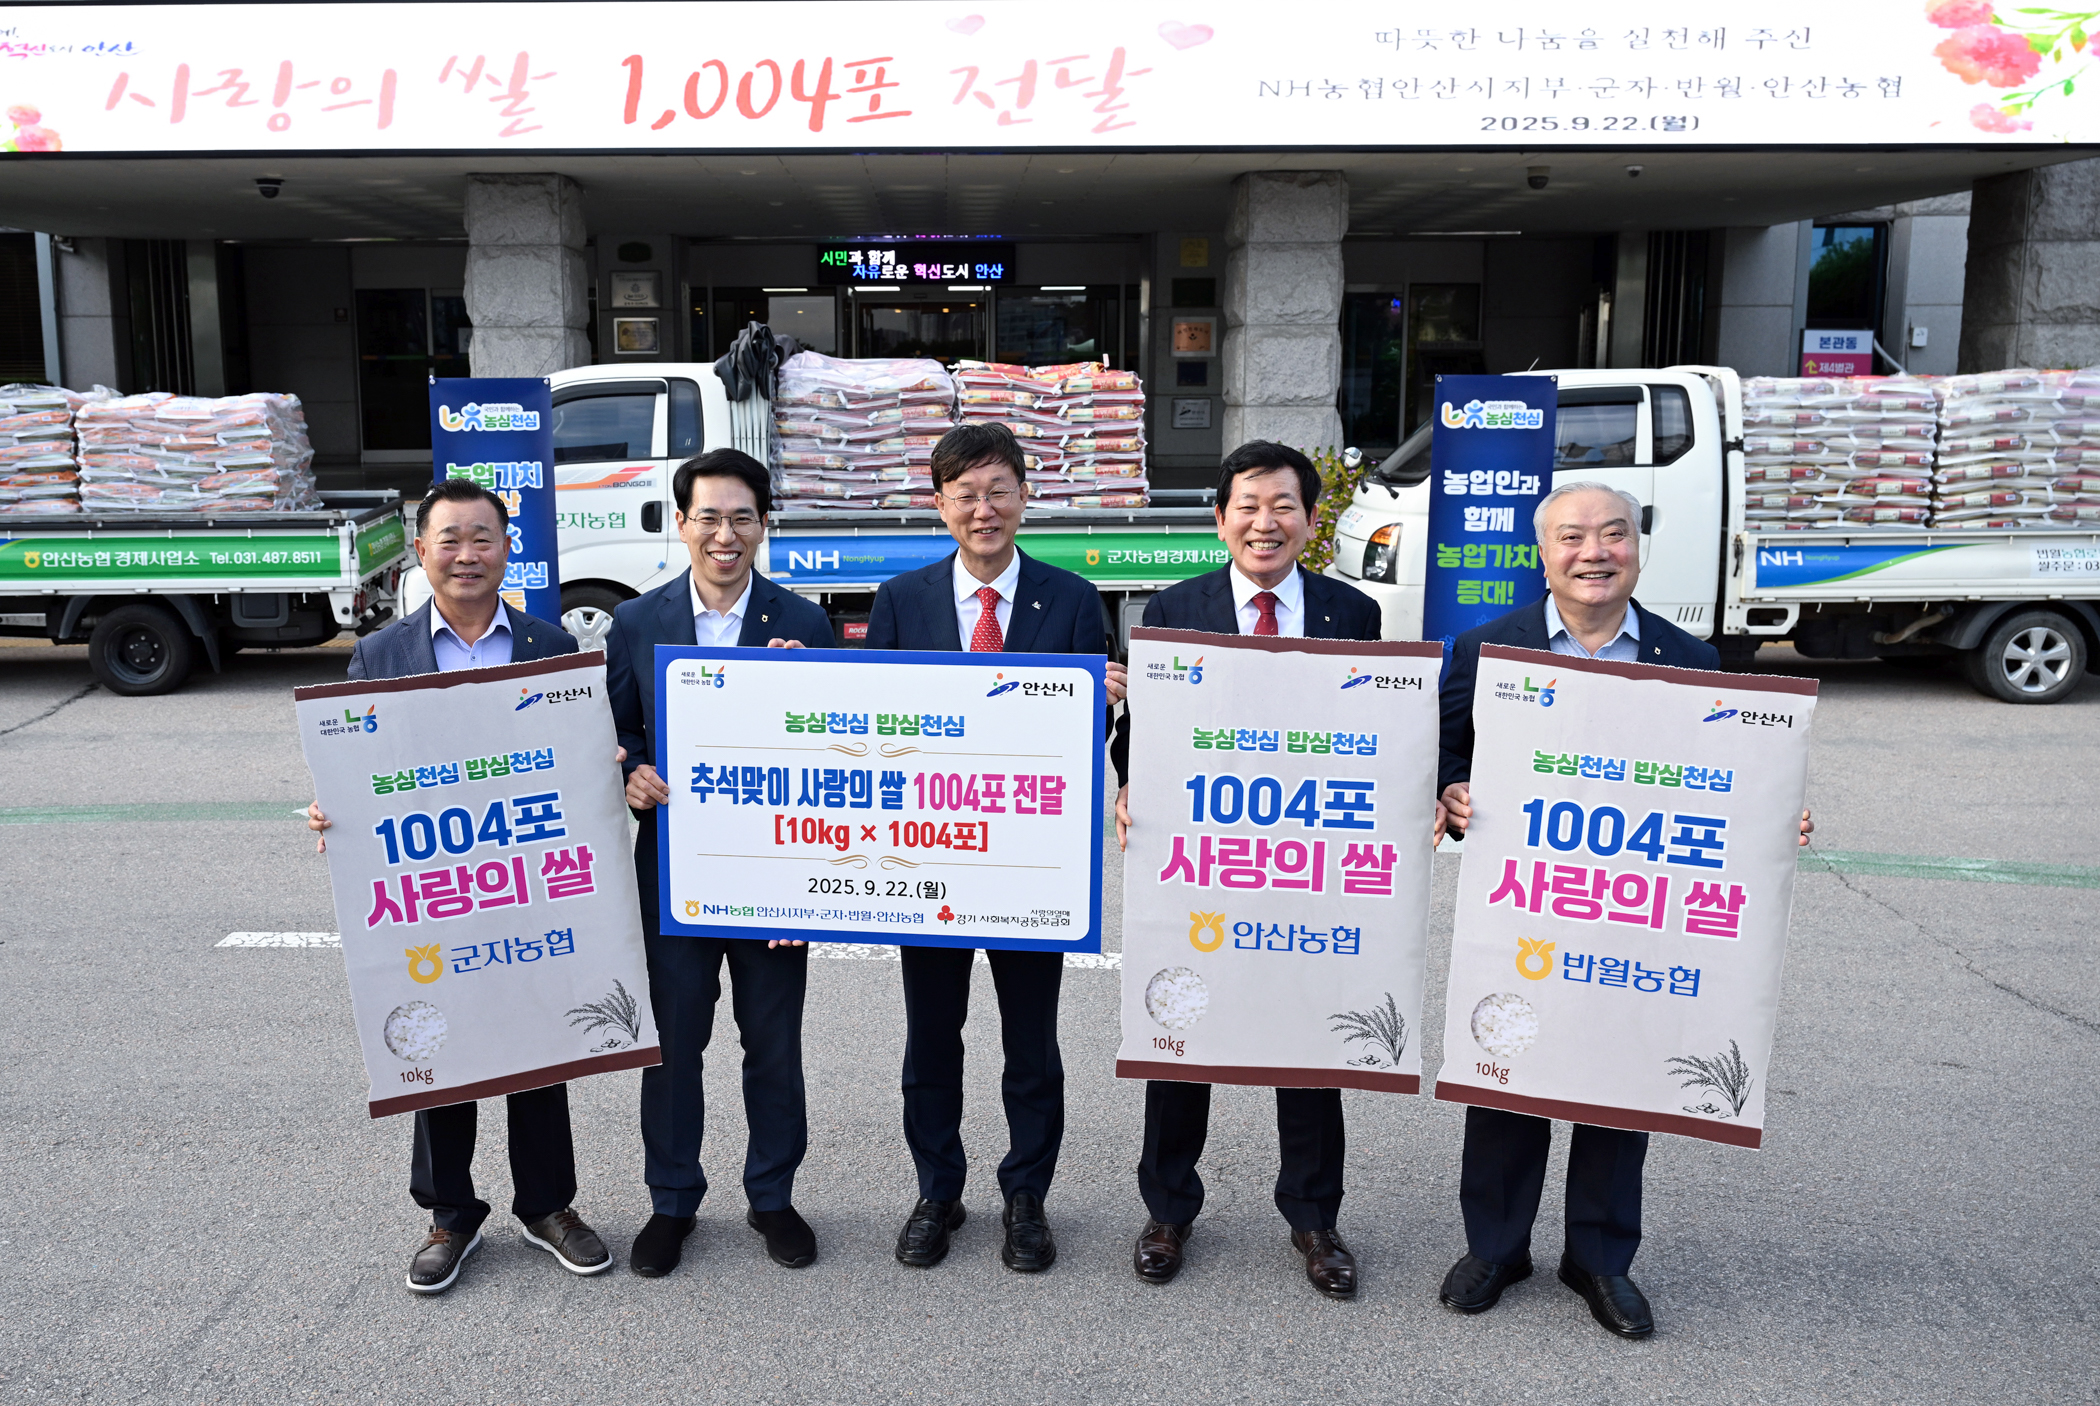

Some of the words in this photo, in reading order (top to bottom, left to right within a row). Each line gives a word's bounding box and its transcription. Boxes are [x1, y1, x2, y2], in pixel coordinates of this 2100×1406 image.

[81, 41, 143, 57] 안산
[1375, 27, 1481, 51] 따뜻한
[1498, 27, 1604, 51] 나눔을
[1623, 26, 1726, 50] 실천해
[1745, 27, 1811, 50] 주신
[105, 60, 397, 133] 사랑의
[438, 51, 558, 137] 쌀
[621, 54, 912, 132] 1,004포
[949, 46, 1153, 134] 전달
[1480, 115, 1699, 132] 2025.9.22.(월)
[820, 250, 864, 266] 시민과
[868, 250, 896, 266] 함께
[852, 264, 909, 279] 자유로운
[913, 263, 969, 279] 혁신도시
[975, 263, 1004, 279] 안산
[1819, 336, 1857, 350] 본관동
[1819, 362, 1855, 374] 제4별관
[484, 414, 537, 428] 농심천심
[1486, 412, 1540, 426] 농심천심
[1443, 470, 1540, 495] 농업인과
[1464, 506, 1514, 532] 함께
[42, 551, 111, 567] 안산농협
[114, 550, 199, 567] 경제사업소
[210, 551, 320, 564] Tel.031.487.8511
[789, 550, 839, 569] NH
[843, 555, 885, 563] NongHyup
[1107, 550, 1233, 564] 군자농협경제사업
[1436, 543, 1538, 569] 농업가치
[1760, 551, 1803, 566] NH
[1457, 580, 1514, 605] 증대!
[1023, 681, 1075, 697] 안산시
[1375, 675, 1422, 690] 안산시
[546, 686, 592, 705] 안산시
[785, 711, 869, 735] 농심천심
[876, 713, 965, 738] 밥심천심
[1740, 711, 1793, 728] 안산시
[1193, 727, 1279, 752] 농심천심
[1287, 730, 1377, 756] 밥심천심
[372, 763, 460, 795] 농심천심
[465, 747, 555, 781] 밥심천심
[1533, 749, 1626, 781] 농심천심
[1634, 759, 1733, 793] 밥심천심
[691, 763, 789, 806] 추석맞이
[797, 768, 872, 809] 사랑의
[879, 770, 906, 810] 쌀
[914, 772, 1006, 814] 1004포
[1013, 775, 1066, 815] 전달
[1186, 774, 1374, 830] 1004포
[375, 792, 566, 865] 1004포
[775, 814, 850, 851] [10kg
[889, 821, 988, 852] 1004포]
[1523, 798, 1727, 869] 1004포
[1160, 836, 1325, 892] 사랑의
[1341, 843, 1397, 895] 쌀
[367, 856, 529, 928] 사랑의
[541, 845, 594, 900] 쌀
[1489, 859, 1669, 929] 사랑의
[1684, 880, 1746, 938] 쌀
[703, 905, 754, 917] NH농협
[956, 914, 976, 925] 경기
[980, 915, 1071, 928] 사회복지공동모금회
[1232, 921, 1361, 955] 안산농협
[450, 928, 575, 973] 군자농협
[1563, 952, 1700, 998] 반월농협
[1152, 1036, 1185, 1057] 10kg
[400, 1068, 434, 1085] 10kg
[1475, 1062, 1510, 1085] 10kg
